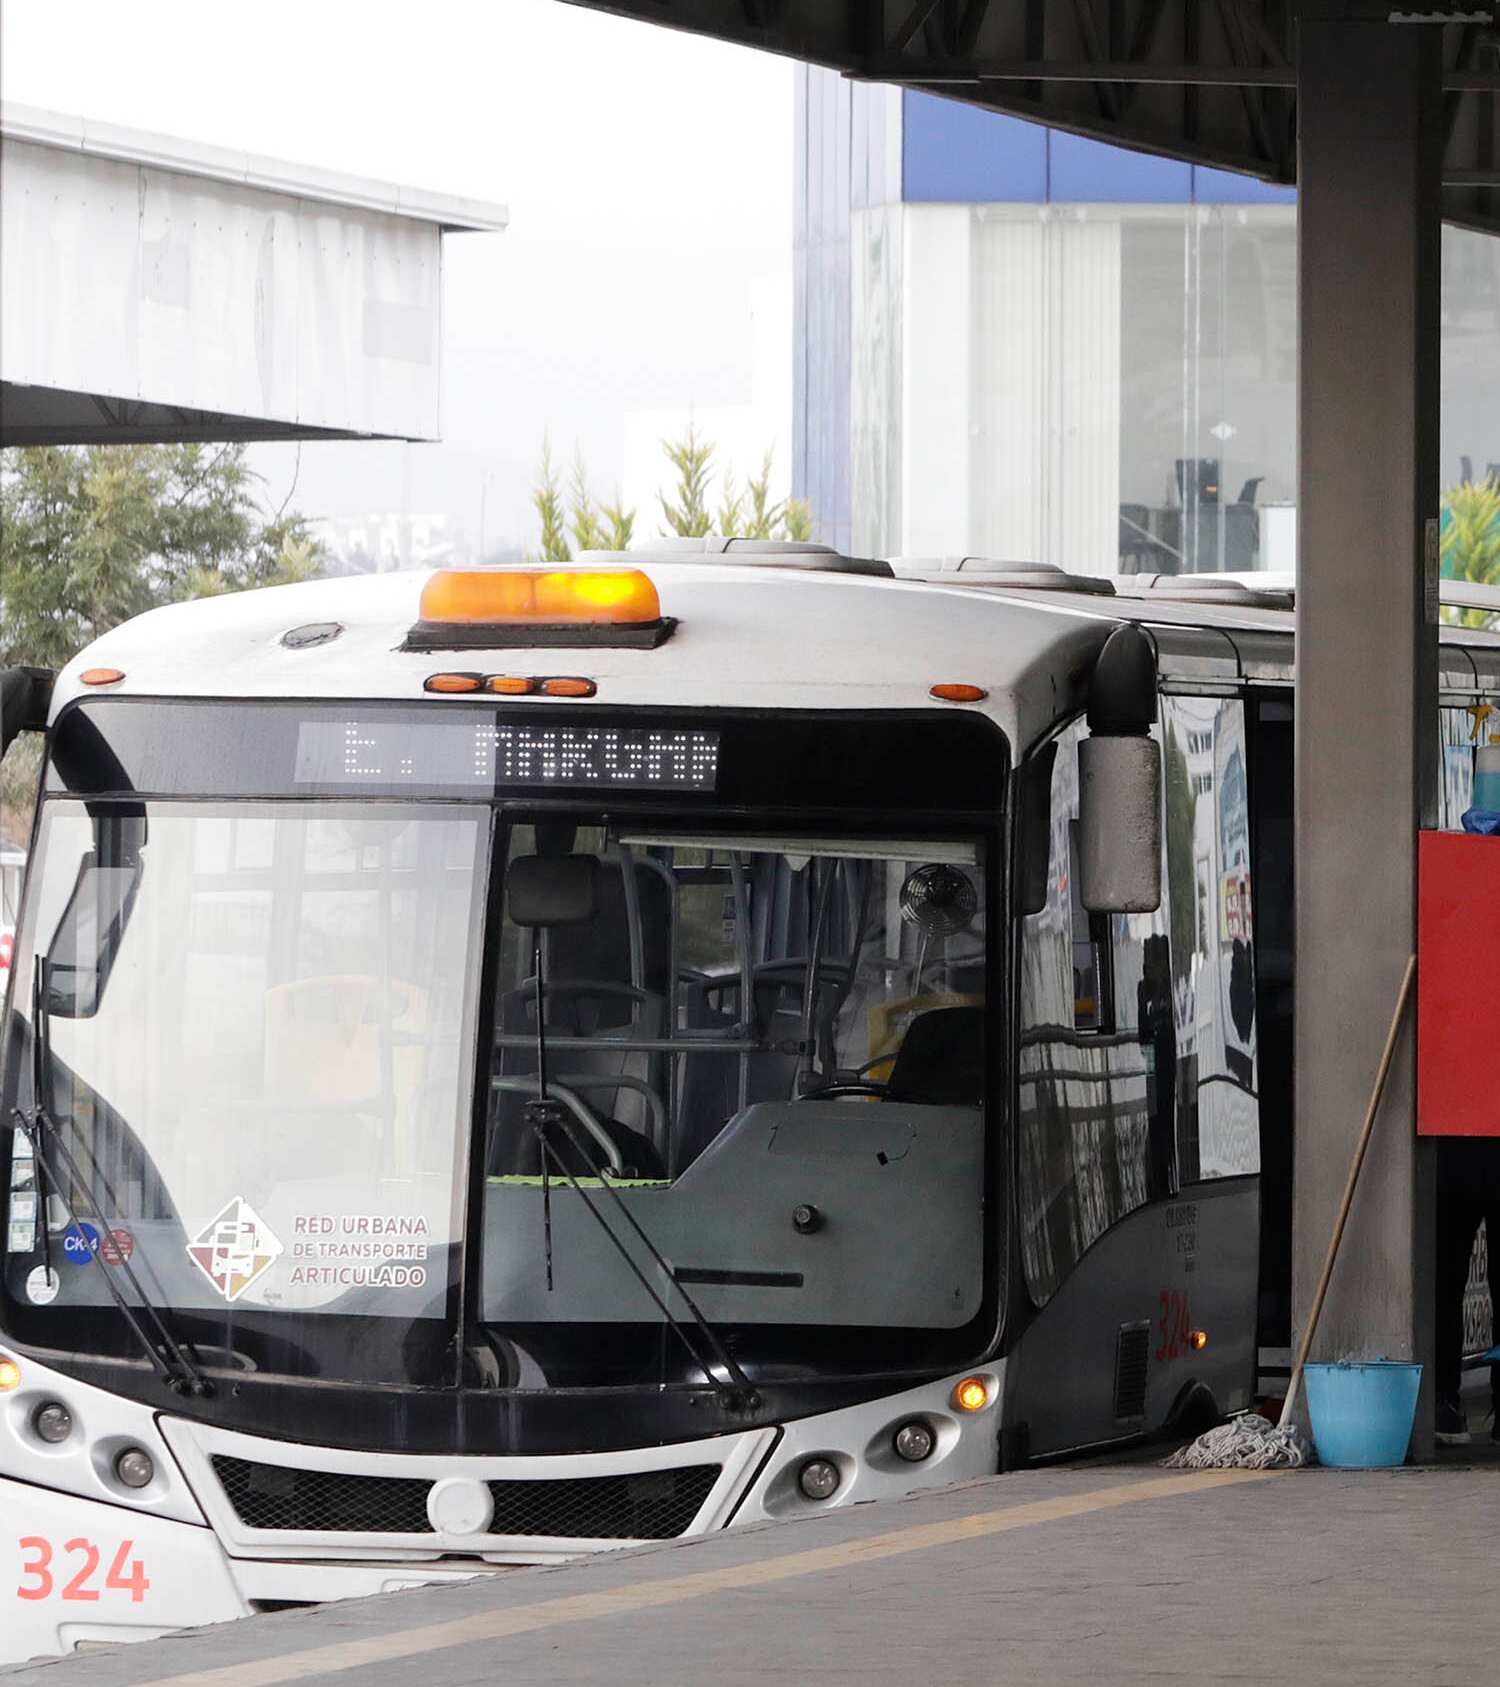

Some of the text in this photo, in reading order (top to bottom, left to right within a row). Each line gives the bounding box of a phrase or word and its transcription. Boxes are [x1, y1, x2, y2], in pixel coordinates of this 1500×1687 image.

[294, 1217, 428, 1235] RED URBANA
[293, 1243, 427, 1258] DE TRANSPORTE
[290, 1266, 425, 1286] ARTICULADO
[17, 1535, 150, 1603] 324
